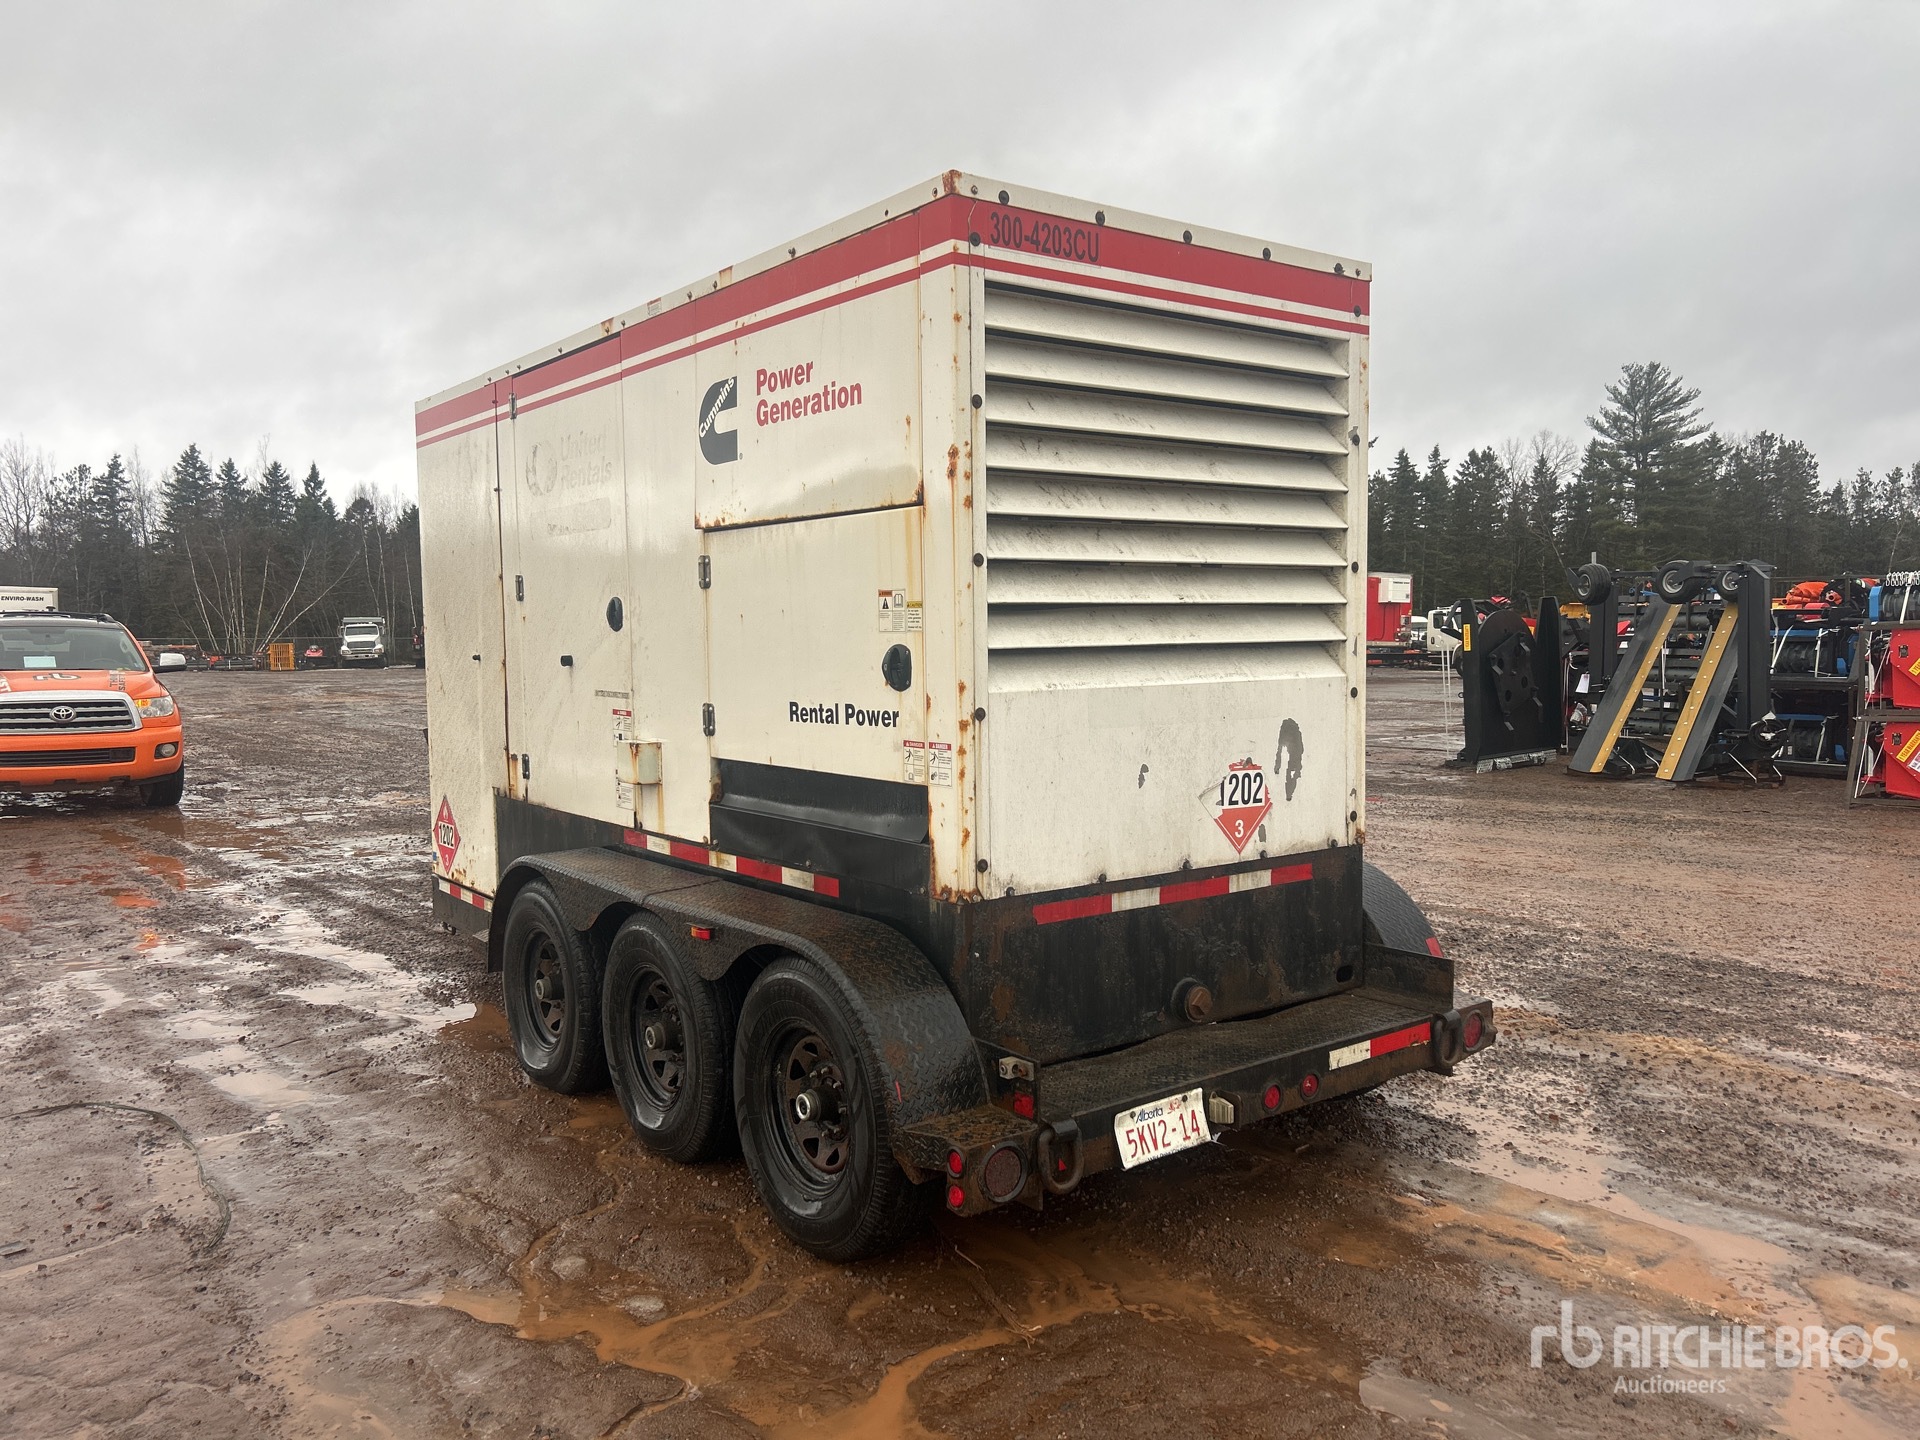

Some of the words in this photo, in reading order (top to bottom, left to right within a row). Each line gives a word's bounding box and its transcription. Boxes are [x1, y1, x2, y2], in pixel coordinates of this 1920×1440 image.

[990, 211, 1099, 262] 300-4203CU
[756, 361, 814, 396] Power
[699, 377, 735, 438] Cummins
[756, 380, 863, 427] Generation
[789, 701, 839, 725] Rental
[844, 703, 900, 728] Power
[439, 823, 454, 848] 1202
[1234, 819, 1244, 838] 3
[444, 853, 450, 867] 3
[1136, 1106, 1164, 1124] Alberta
[1125, 1109, 1201, 1159] 5KV2-14
